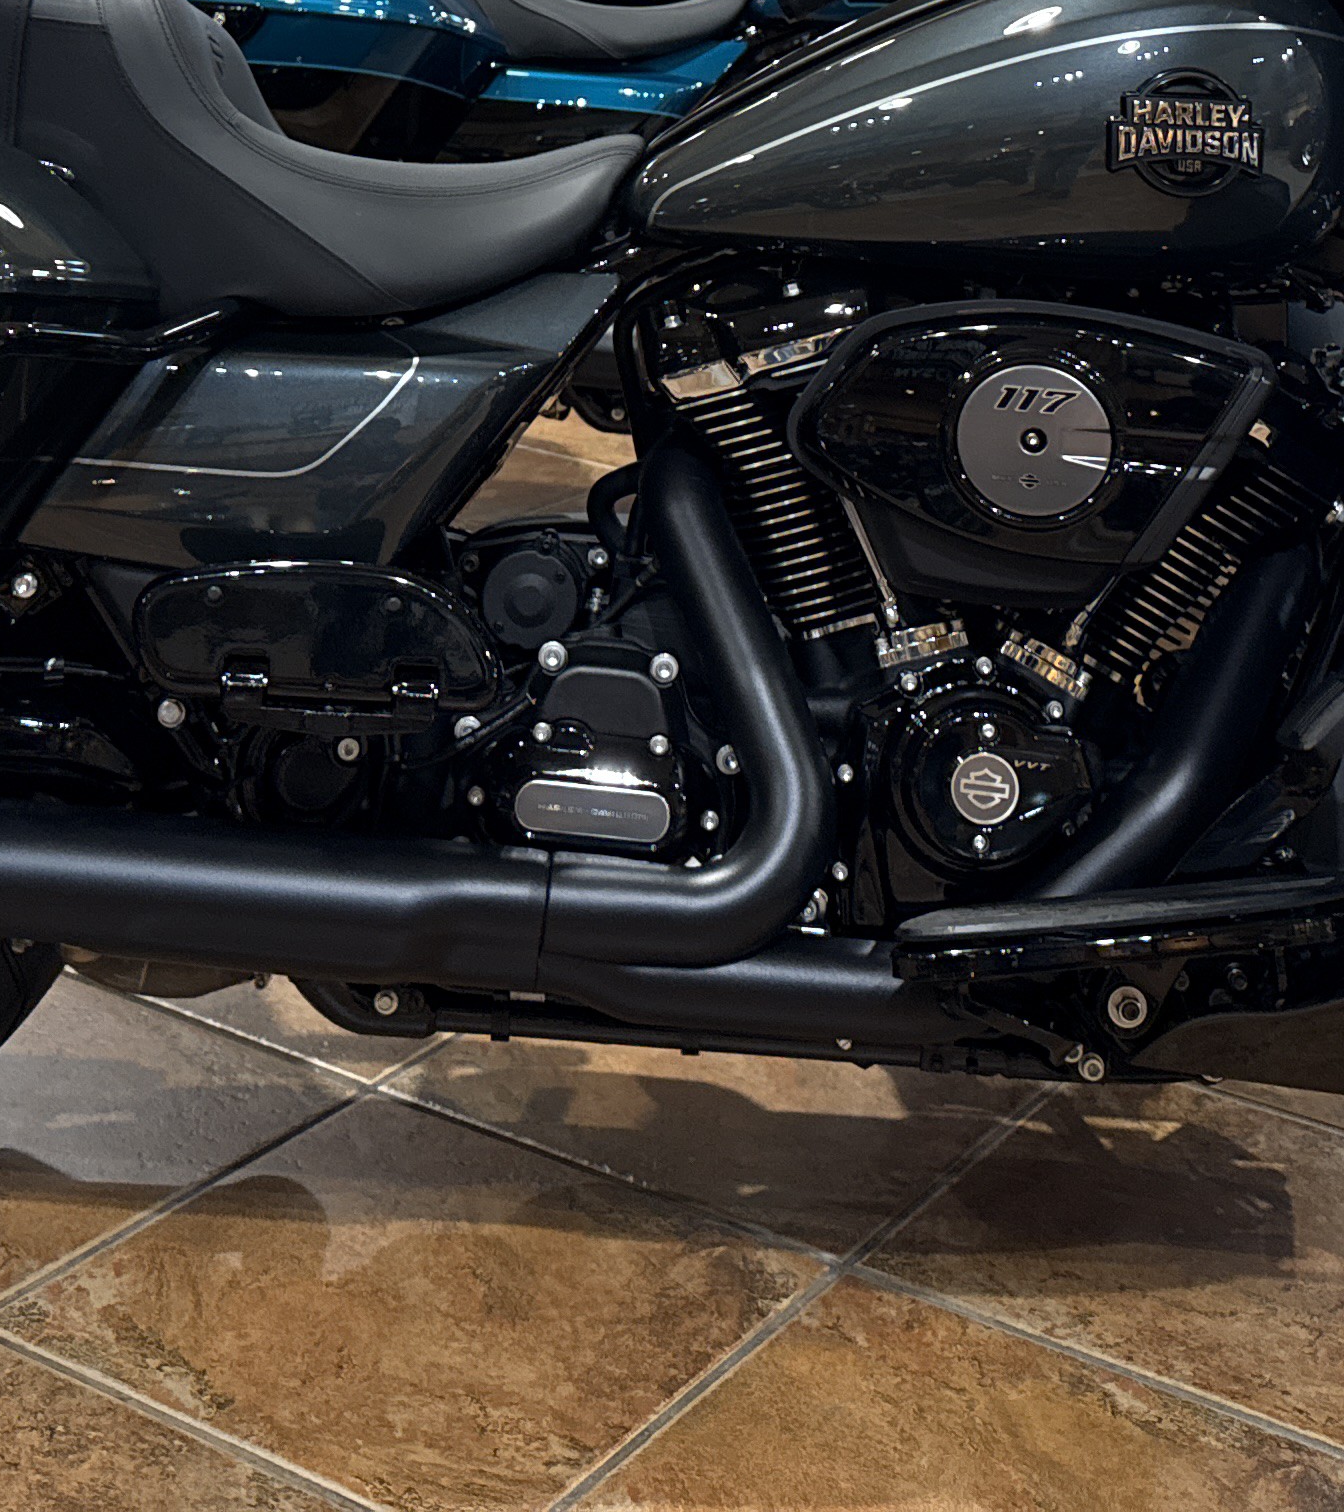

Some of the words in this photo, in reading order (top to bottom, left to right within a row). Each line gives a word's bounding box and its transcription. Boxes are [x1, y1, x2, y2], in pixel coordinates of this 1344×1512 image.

[1118, 125, 1260, 168] DAVIDSON
[1177, 159, 1203, 173] USA
[994, 384, 1082, 415] 117
[1014, 759, 1051, 772] VVT
